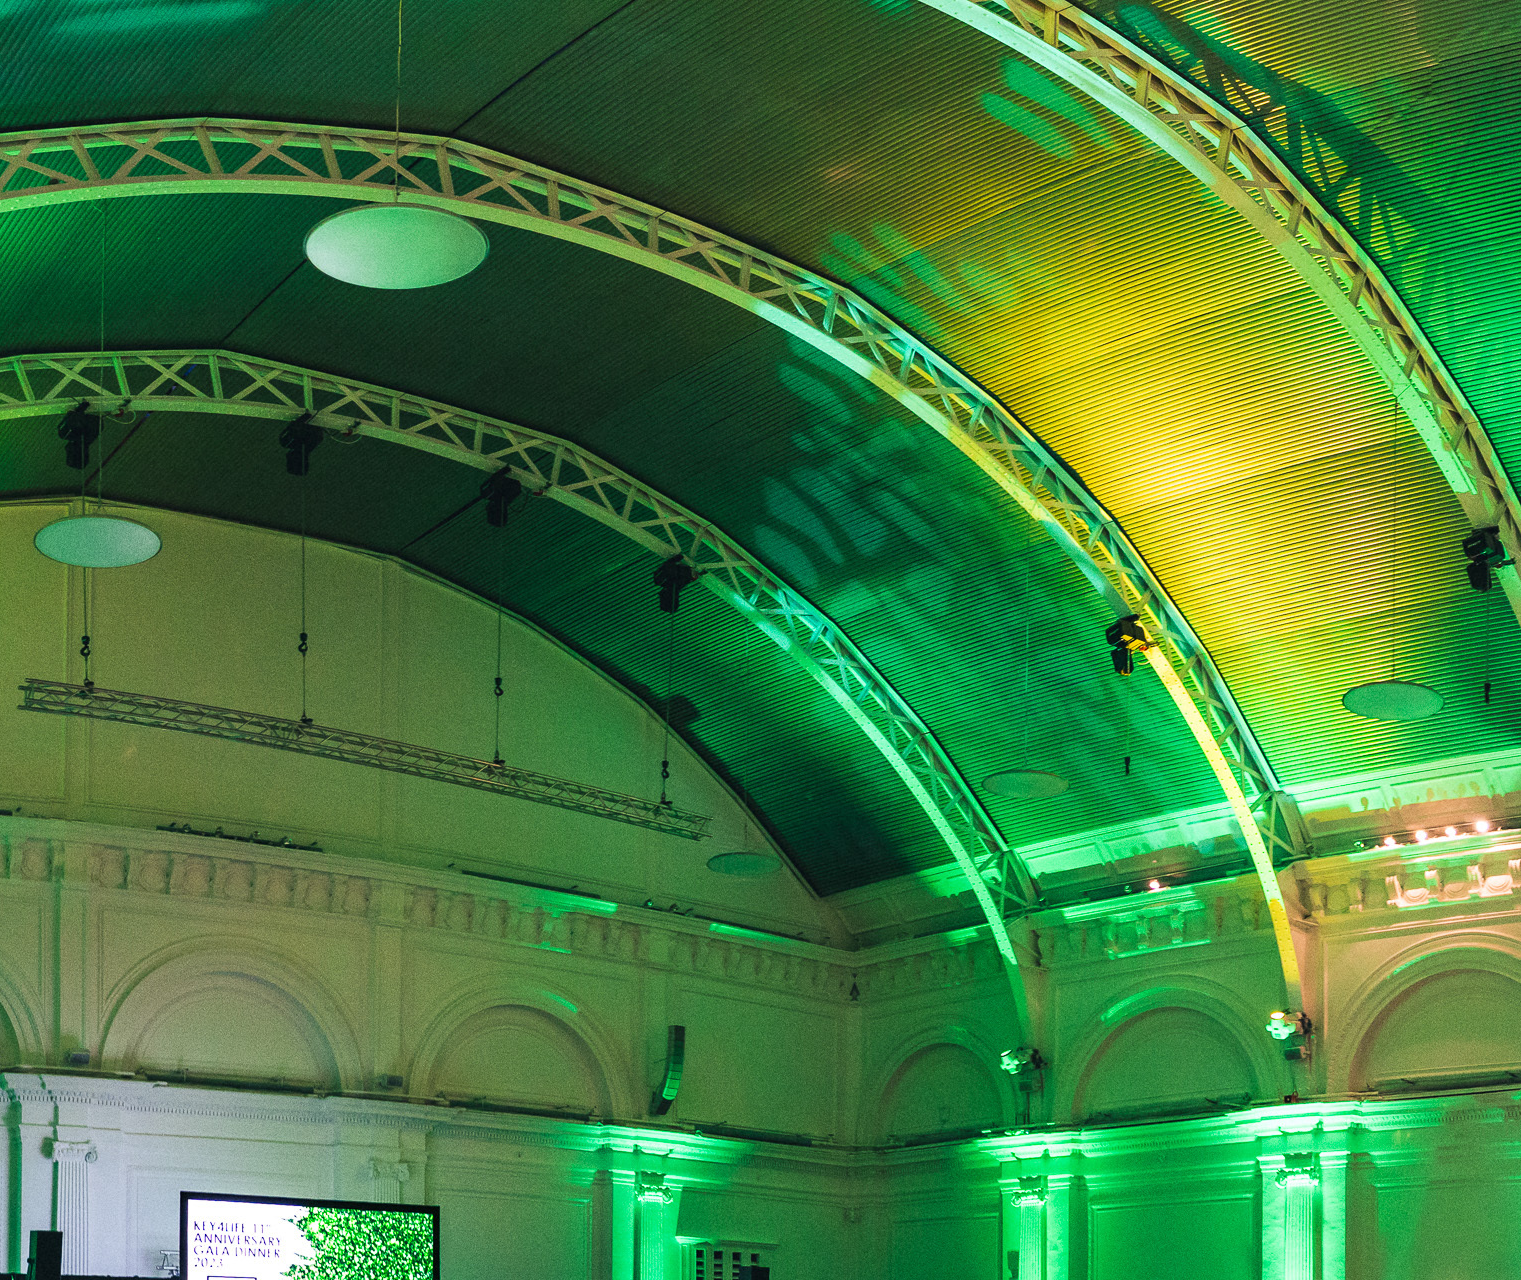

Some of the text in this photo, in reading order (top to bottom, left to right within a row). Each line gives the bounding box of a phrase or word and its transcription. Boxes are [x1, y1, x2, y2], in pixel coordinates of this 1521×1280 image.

[193, 1221, 245, 1233] KEY4LIFE
[194, 1233, 280, 1246] ANNIVERSARY
[193, 1245, 229, 1256] GALA
